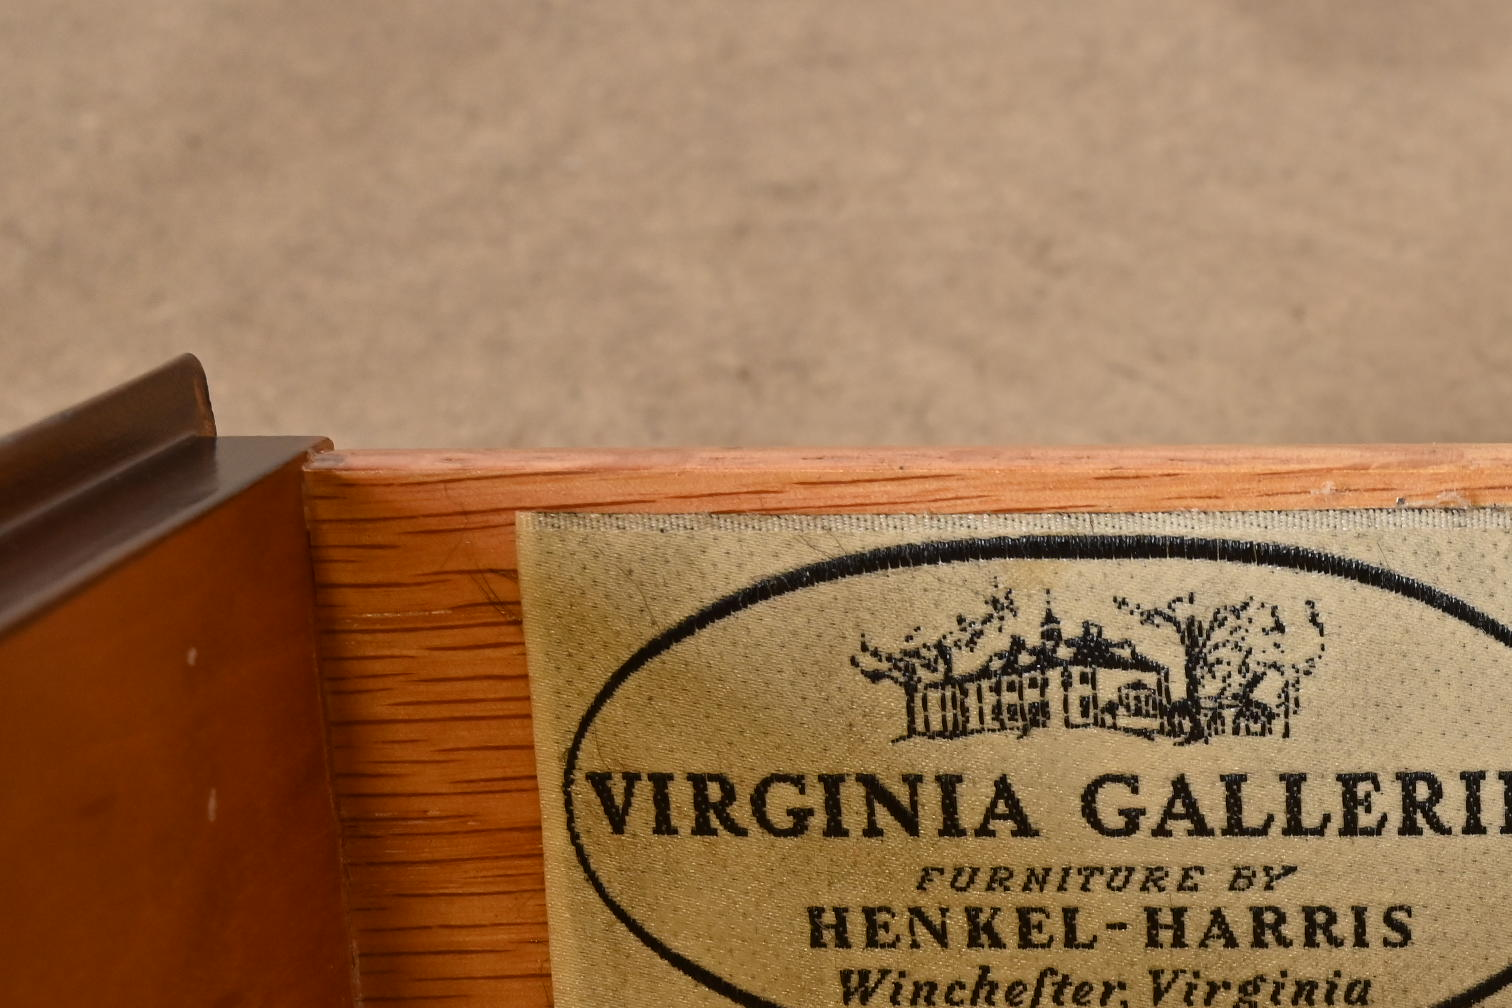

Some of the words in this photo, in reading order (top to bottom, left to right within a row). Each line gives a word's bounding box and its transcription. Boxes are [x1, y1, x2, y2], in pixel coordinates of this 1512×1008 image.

[585, 771, 1041, 840] VIRGINIA
[915, 866, 1202, 895] FURNITURE
[1227, 864, 1298, 894] BY
[806, 904, 1415, 952] HENKEL-HARRIS
